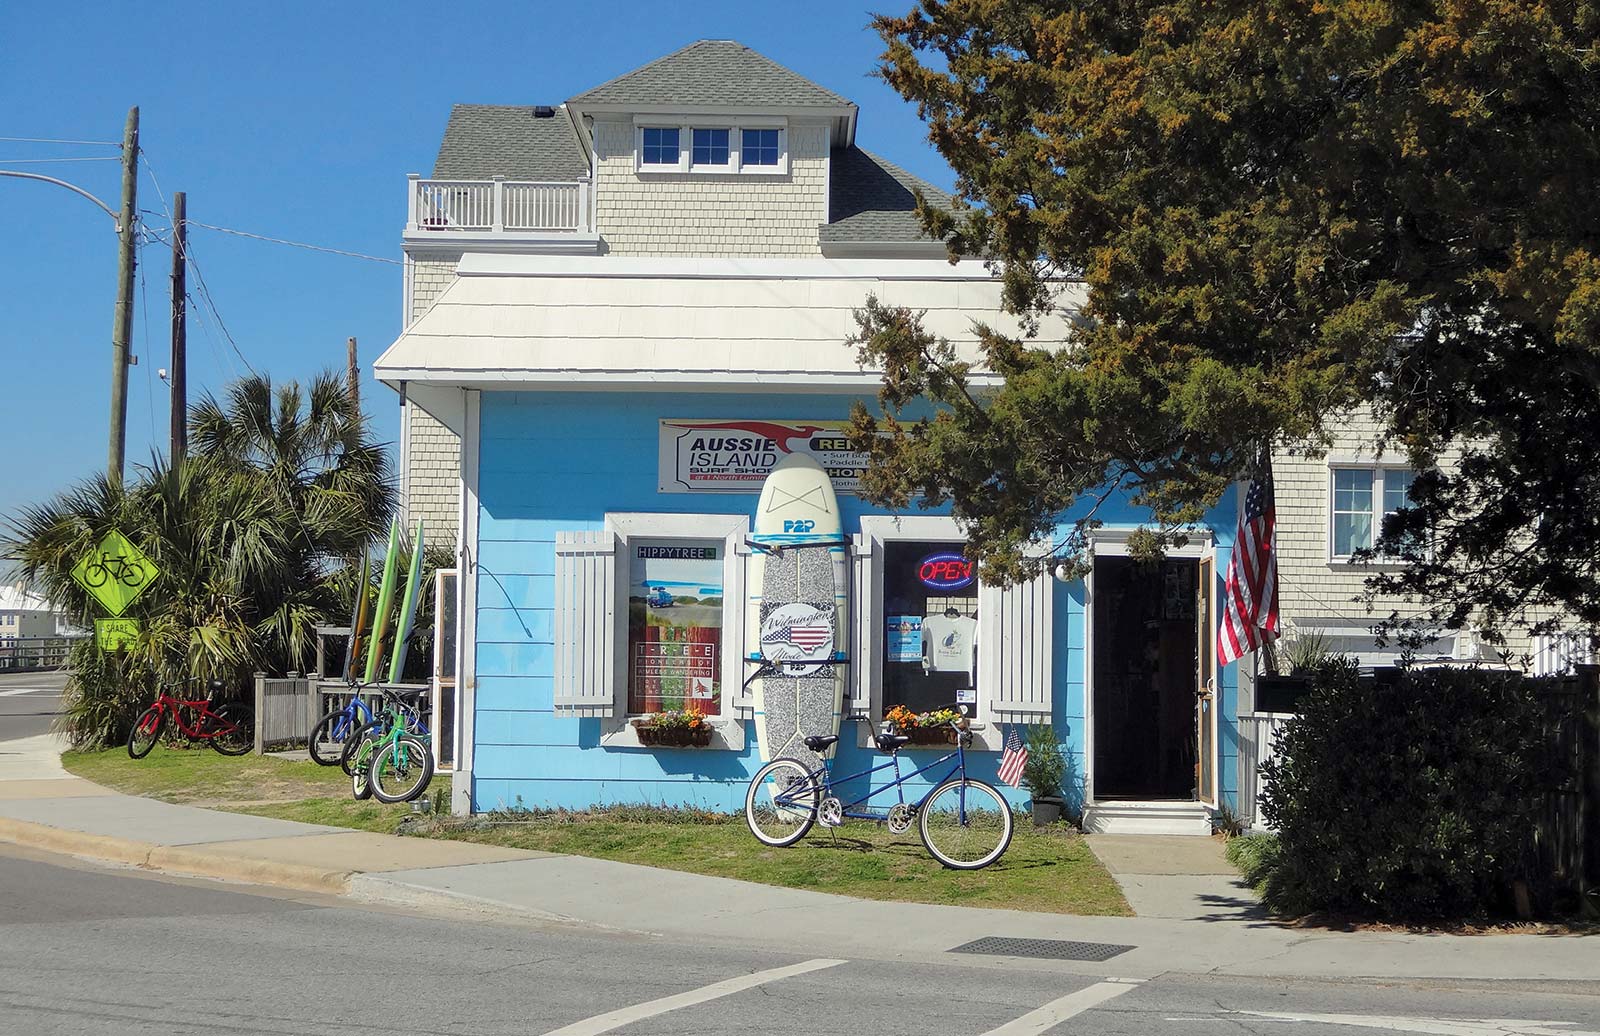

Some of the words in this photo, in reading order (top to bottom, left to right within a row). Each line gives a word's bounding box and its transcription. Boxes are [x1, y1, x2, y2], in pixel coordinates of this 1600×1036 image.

[690, 438, 777, 452] AUSSIE
[690, 452, 777, 467] ISLAND
[828, 468, 863, 477] HOP
[784, 519, 815, 533] P2P
[638, 548, 705, 558] HIPPYTREE
[919, 561, 973, 580] OPEN
[106, 624, 128, 632] SHARE
[101, 637, 113, 646] THE
